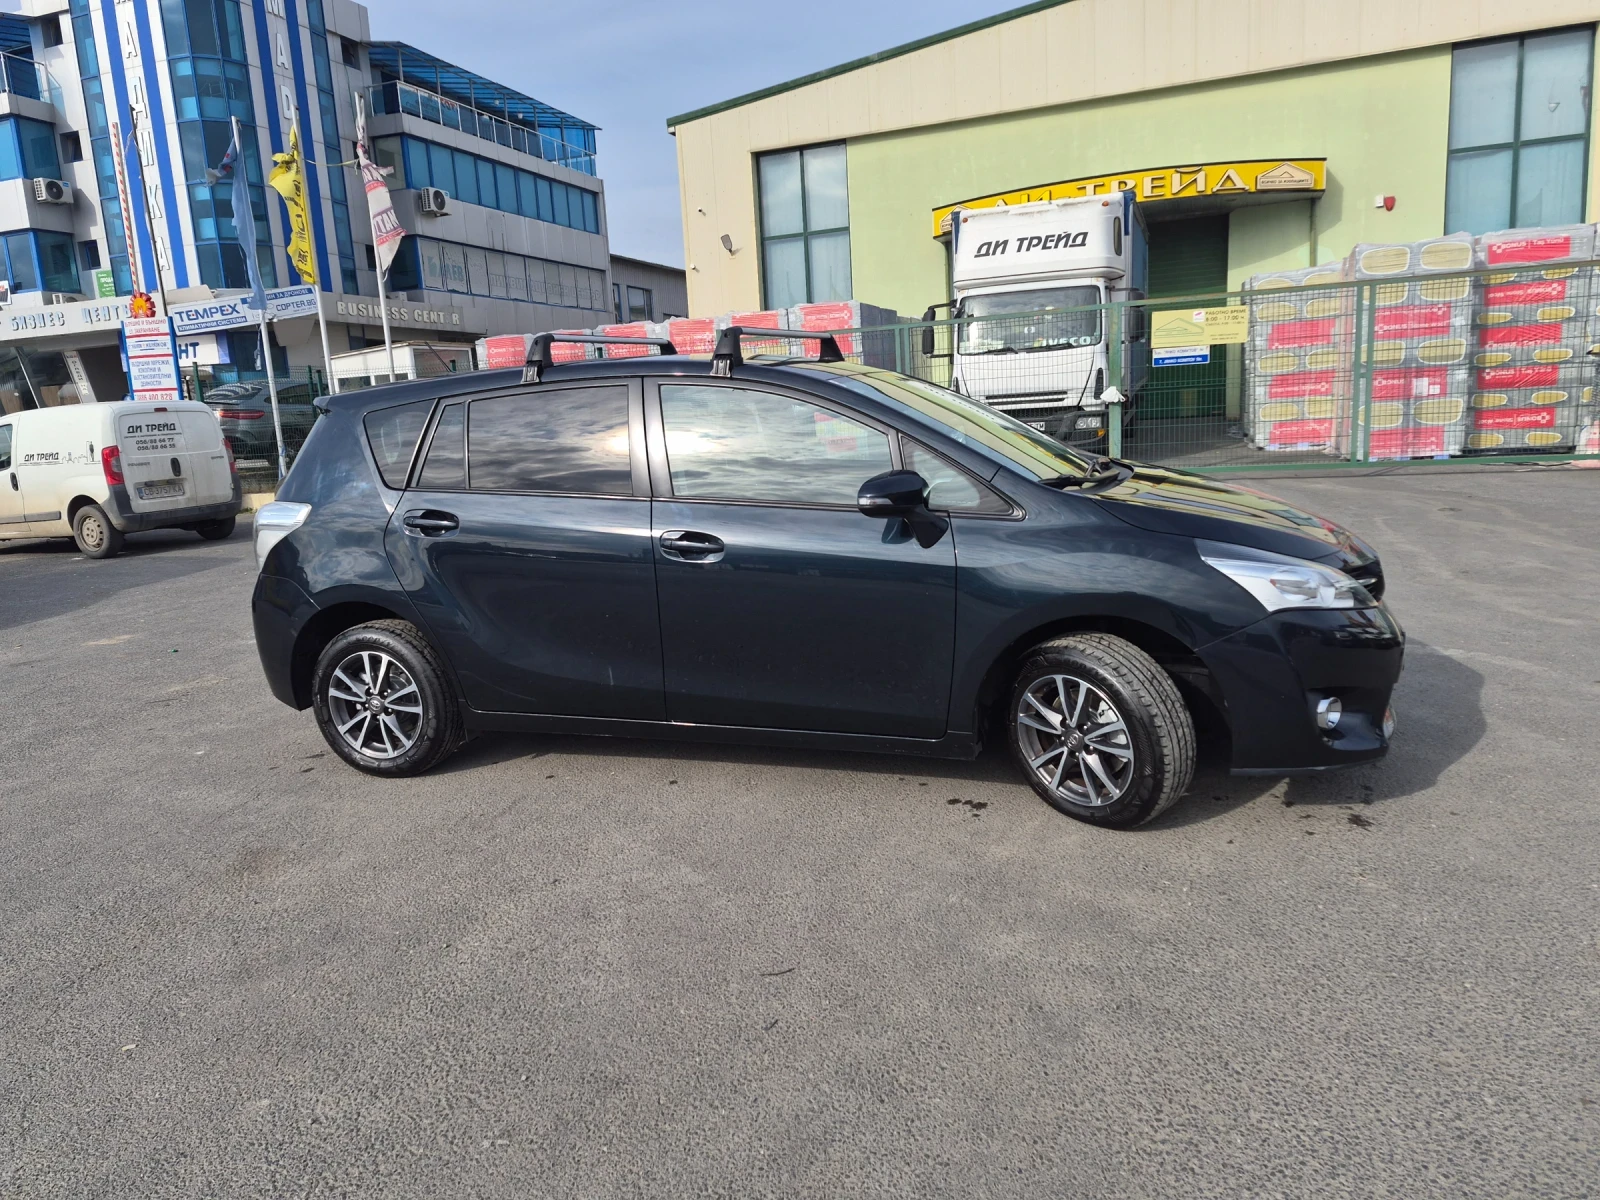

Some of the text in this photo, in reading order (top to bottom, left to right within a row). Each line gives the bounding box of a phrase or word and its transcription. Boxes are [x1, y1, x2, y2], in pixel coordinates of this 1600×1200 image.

[116, 0, 171, 271] АДИКА
[1077, 166, 1250, 198] ТРЕЙД
[973, 231, 1089, 258] ДИ ТРЕЙД
[174, 303, 241, 322] TEMPEX
[275, 299, 317, 311] COPTER.BG
[336, 301, 460, 325] BUSINESS CENTR
[10, 311, 65, 331] БИЗНЕС
[217, 316, 247, 326] СИСТЕМИ
[1041, 336, 1091, 347] IVECO
[127, 422, 176, 434] ДИ ТРЕЙД
[24, 452, 59, 462] ДИ ТРЕЙД
